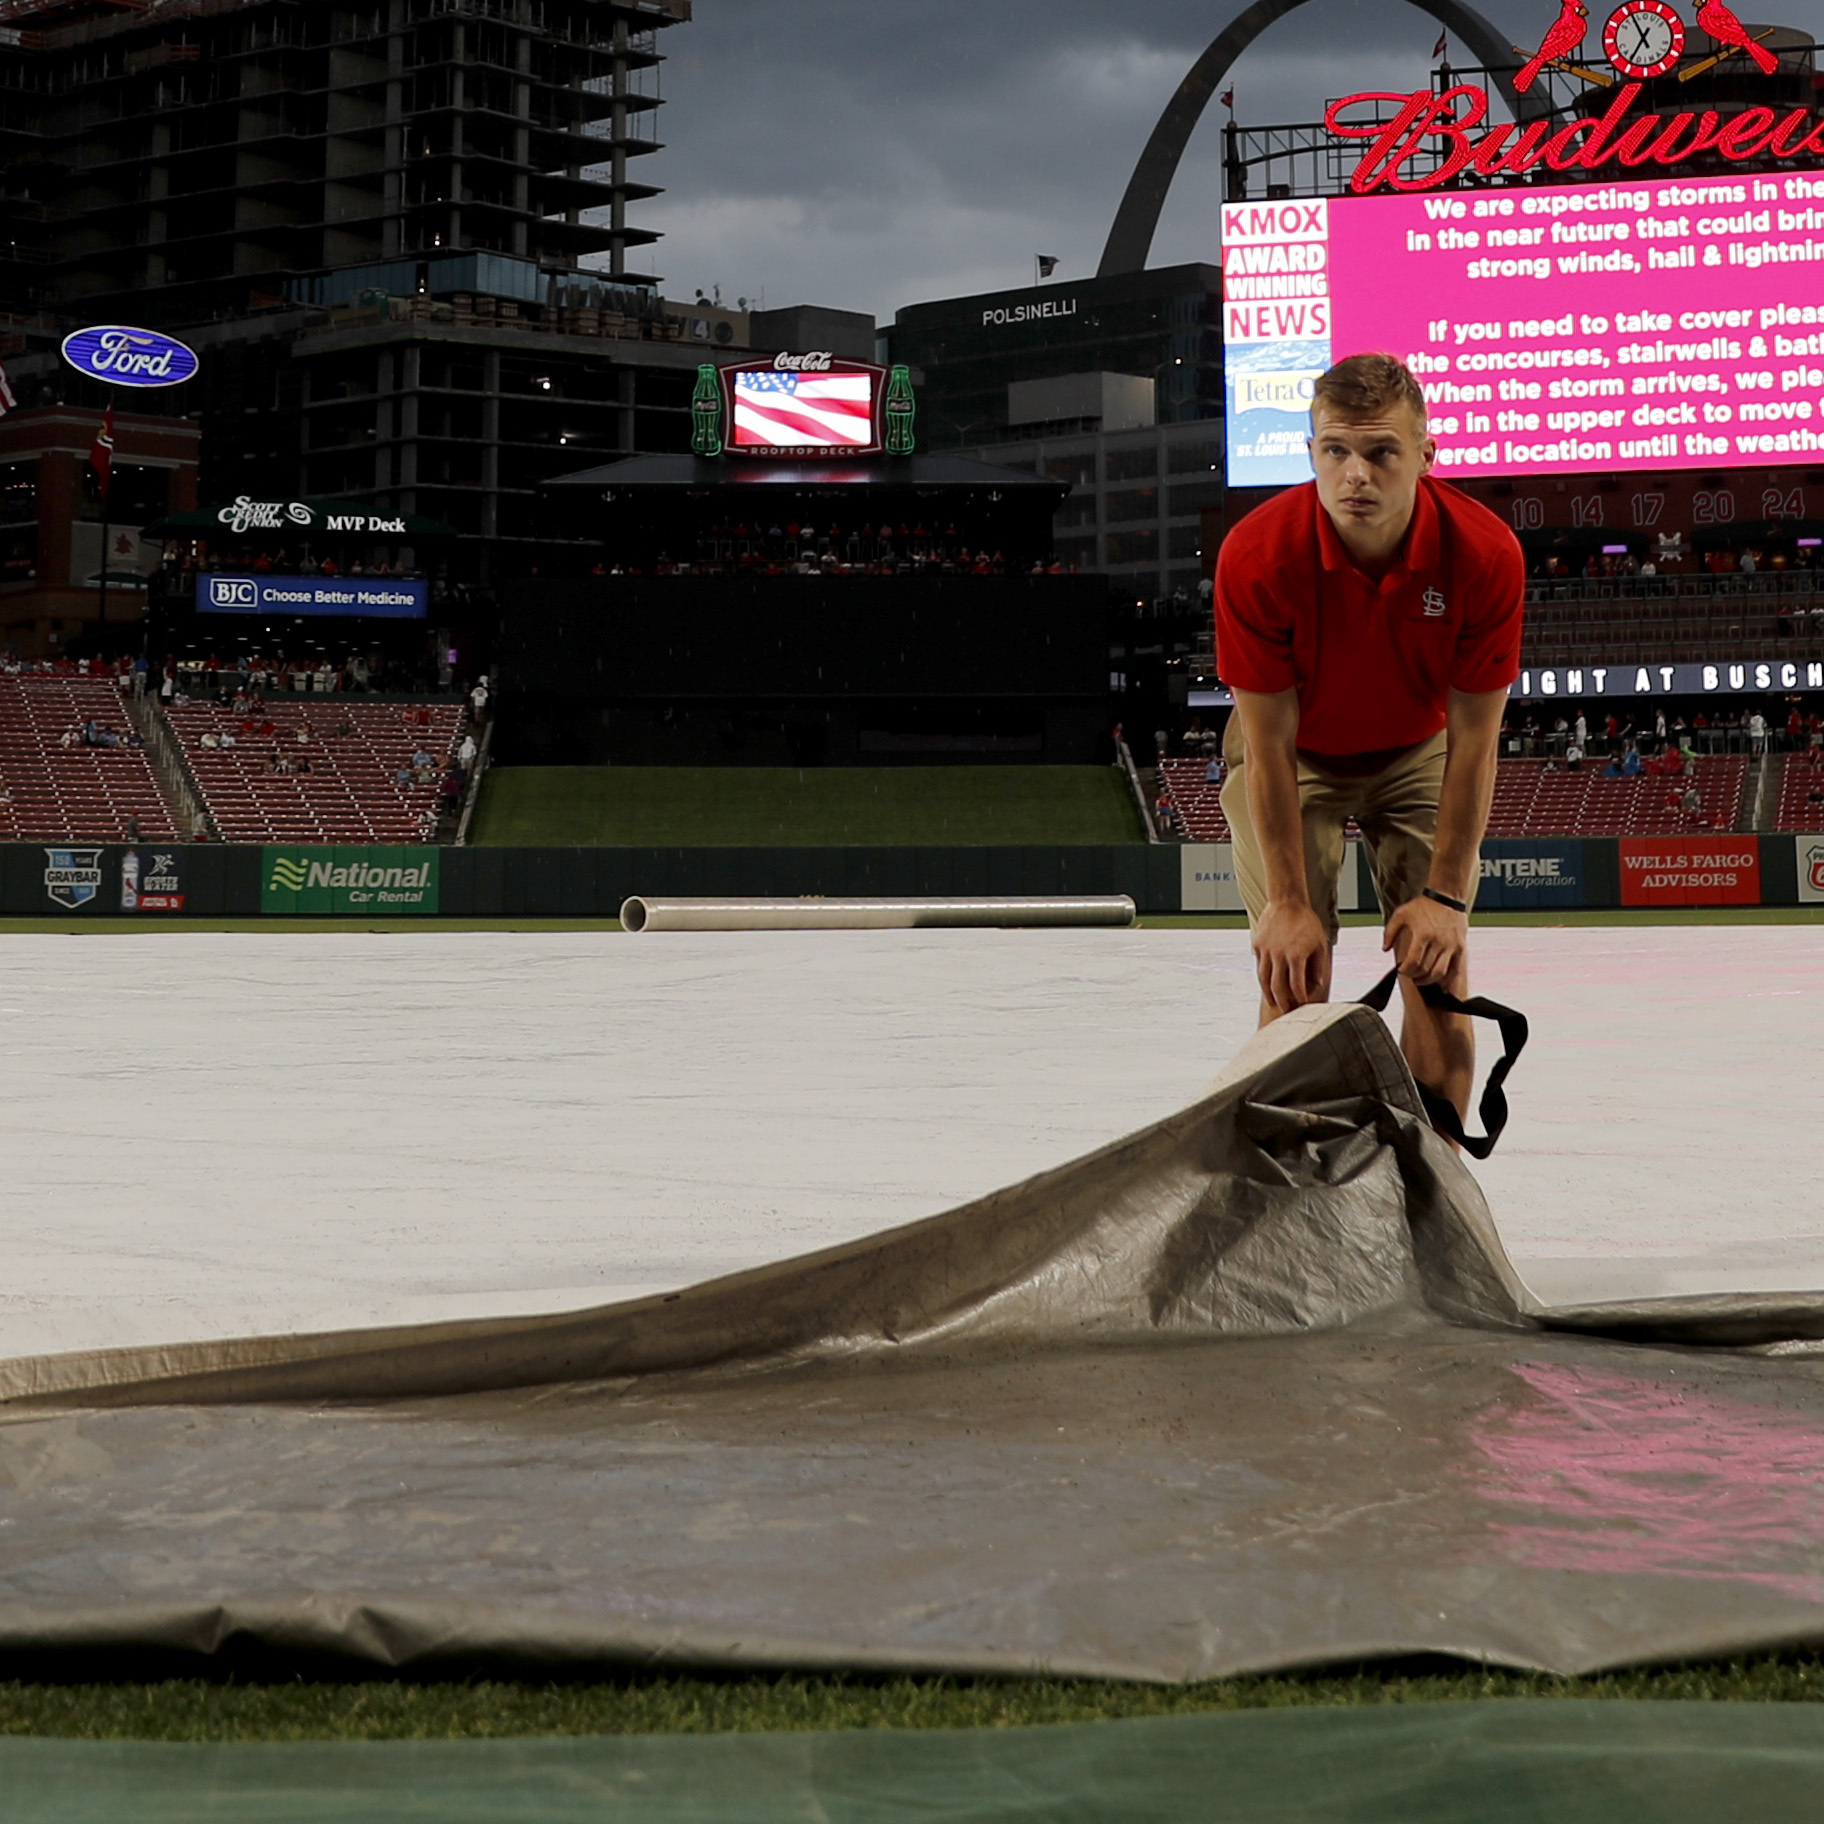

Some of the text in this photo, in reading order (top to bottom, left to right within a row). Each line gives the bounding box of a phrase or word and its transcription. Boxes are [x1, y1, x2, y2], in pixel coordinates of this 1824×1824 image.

[1424, 198, 1466, 220] We
[1473, 198, 1514, 218] are
[1521, 189, 1650, 217] expecting
[1657, 183, 1746, 207] storms
[1753, 179, 1779, 202] in
[1224, 204, 1324, 237] KMOX
[1406, 229, 1431, 252] in
[1437, 227, 1480, 250] the
[1487, 227, 1544, 247] near
[1551, 221, 1630, 244] future
[1636, 215, 1690, 238] that
[1697, 210, 1771, 236] could
[1225, 243, 1327, 276] AWARD
[1466, 256, 1551, 280] strong
[1557, 249, 1642, 275] winds,
[1648, 245, 1696, 269] hail
[1703, 244, 1722, 267] &
[1225, 273, 1328, 301] WINNING
[982, 298, 1078, 326] POLSINELLI
[1229, 302, 1327, 340] NEWS
[1428, 319, 1448, 342] If
[1453, 321, 1502, 345] you
[1508, 313, 1574, 338] need
[1580, 314, 1609, 336] to
[1615, 309, 1673, 334] take
[1679, 308, 1753, 330] cover
[92, 330, 174, 380] Ford
[1406, 351, 1449, 374] the
[1455, 346, 1610, 373] concourses,
[1617, 338, 1742, 365] stairwells
[1749, 336, 1768, 358] &
[1422, 380, 1492, 404] When
[1498, 378, 1542, 401] the
[1548, 376, 1624, 398] storm
[1630, 370, 1728, 395] arrives,
[1734, 369, 1774, 390] we
[1466, 411, 1490, 434] in
[1497, 409, 1540, 432] the
[1547, 408, 1625, 433] upper
[1632, 401, 1697, 426] deck
[1703, 401, 1732, 423] to
[1739, 399, 1813, 421] move
[750, 447, 857, 456] ROOFTOP DECK
[326, 515, 407, 534] MVP Deck
[1512, 496, 1545, 530] 10
[1571, 495, 1604, 528] 14
[1631, 492, 1665, 527] 17
[1692, 490, 1736, 525] 20
[1762, 487, 1806, 522] 24
[262, 588, 416, 606] Choose Better Medicine
[1634, 661, 1824, 693] AT BUSCH
[46, 869, 100, 885] GRAYBAR
[1623, 853, 1754, 870] WELLS FARGO
[349, 890, 424, 904] Car Rental
[1504, 874, 1577, 888] Corporation
[1641, 872, 1738, 889] ADVISORS
